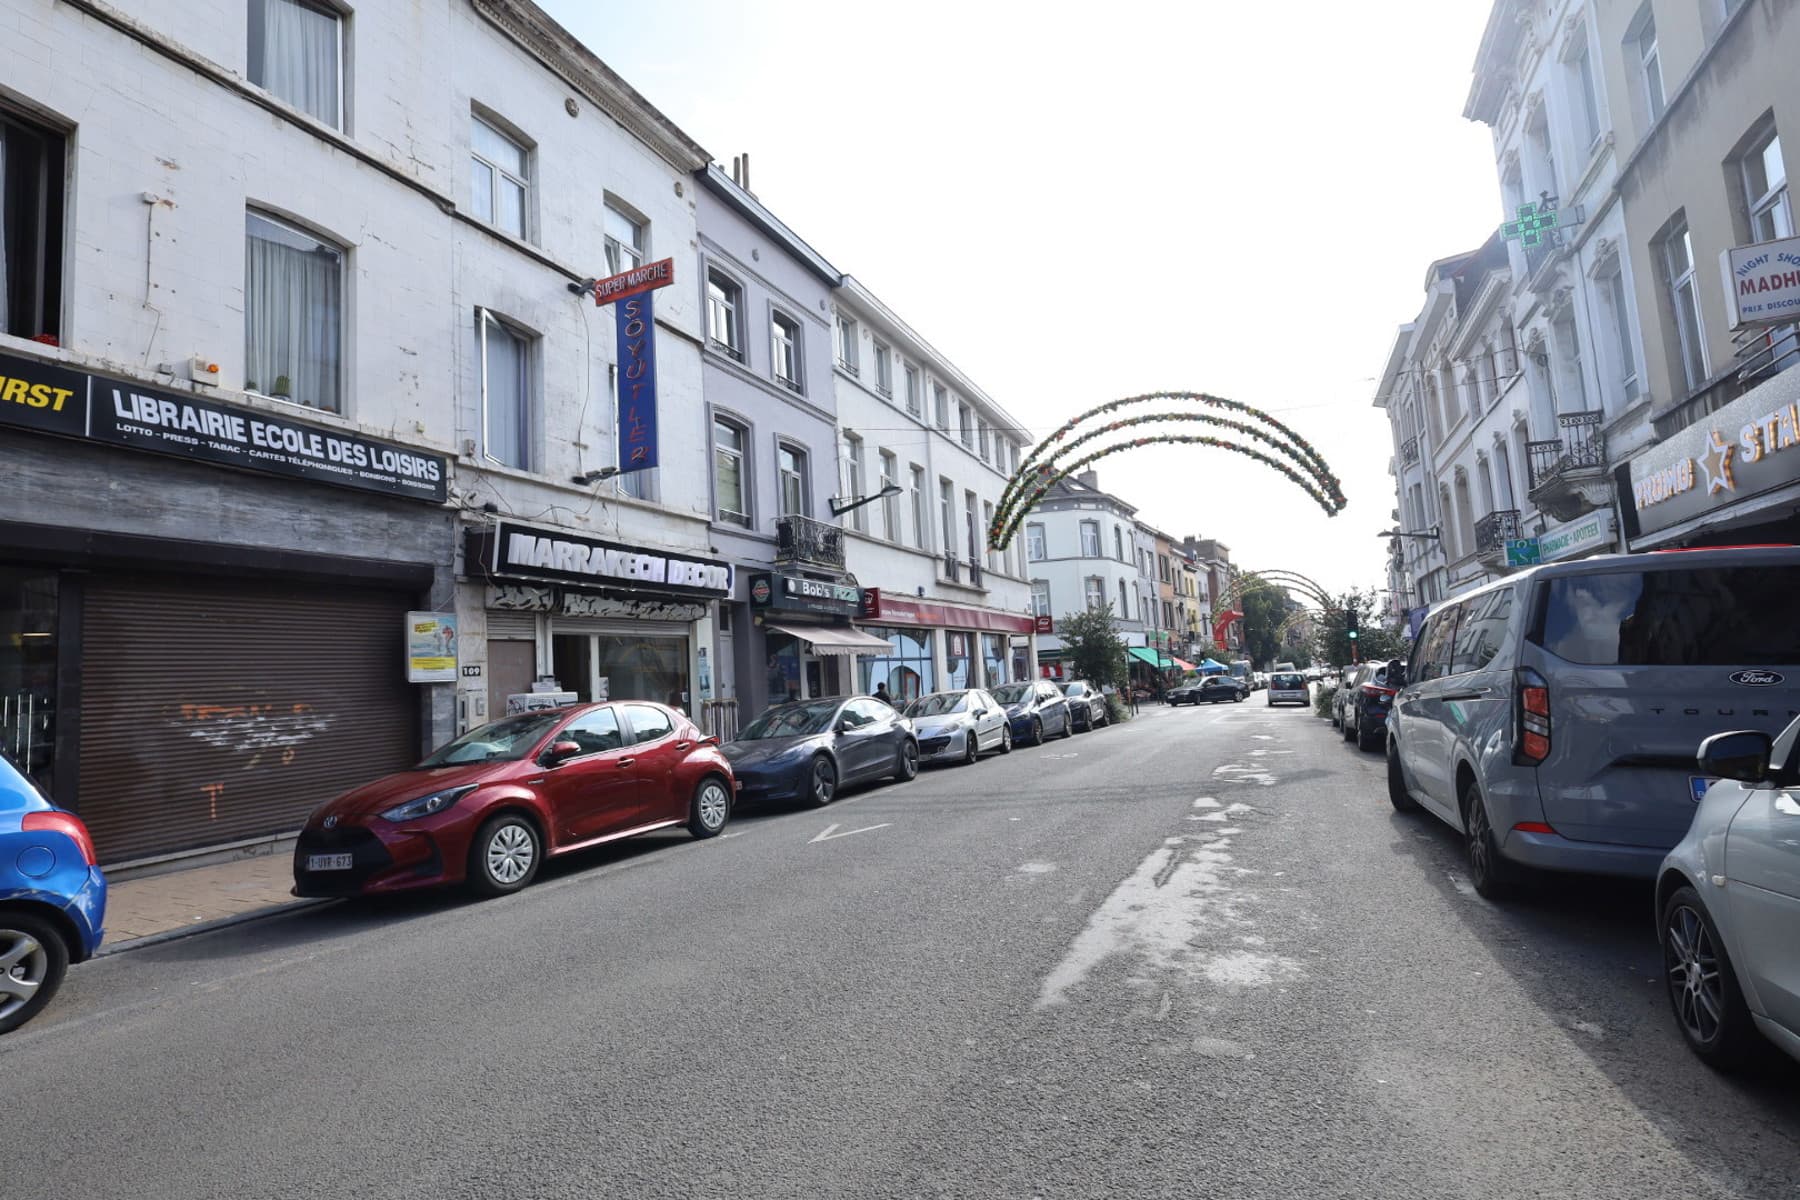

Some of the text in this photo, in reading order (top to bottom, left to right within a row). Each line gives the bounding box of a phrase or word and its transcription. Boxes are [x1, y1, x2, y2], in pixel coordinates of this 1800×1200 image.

[1736, 252, 1800, 277] NIGHT SHO
[596, 276, 625, 297] SUPER
[1742, 304, 1763, 313] PRIX
[112, 389, 440, 481] LIBRAIRIE ECOLE DES LOISIRS
[116, 423, 153, 437] LOTTO
[163, 432, 199, 445] PRESS
[208, 441, 241, 454] TABAC
[249, 450, 286, 463] CARTES
[1739, 398, 1800, 463] STA
[507, 532, 729, 591] MARRAKECH DECOR
[463, 667, 480, 675] 109
[1740, 671, 1774, 684] Ford
